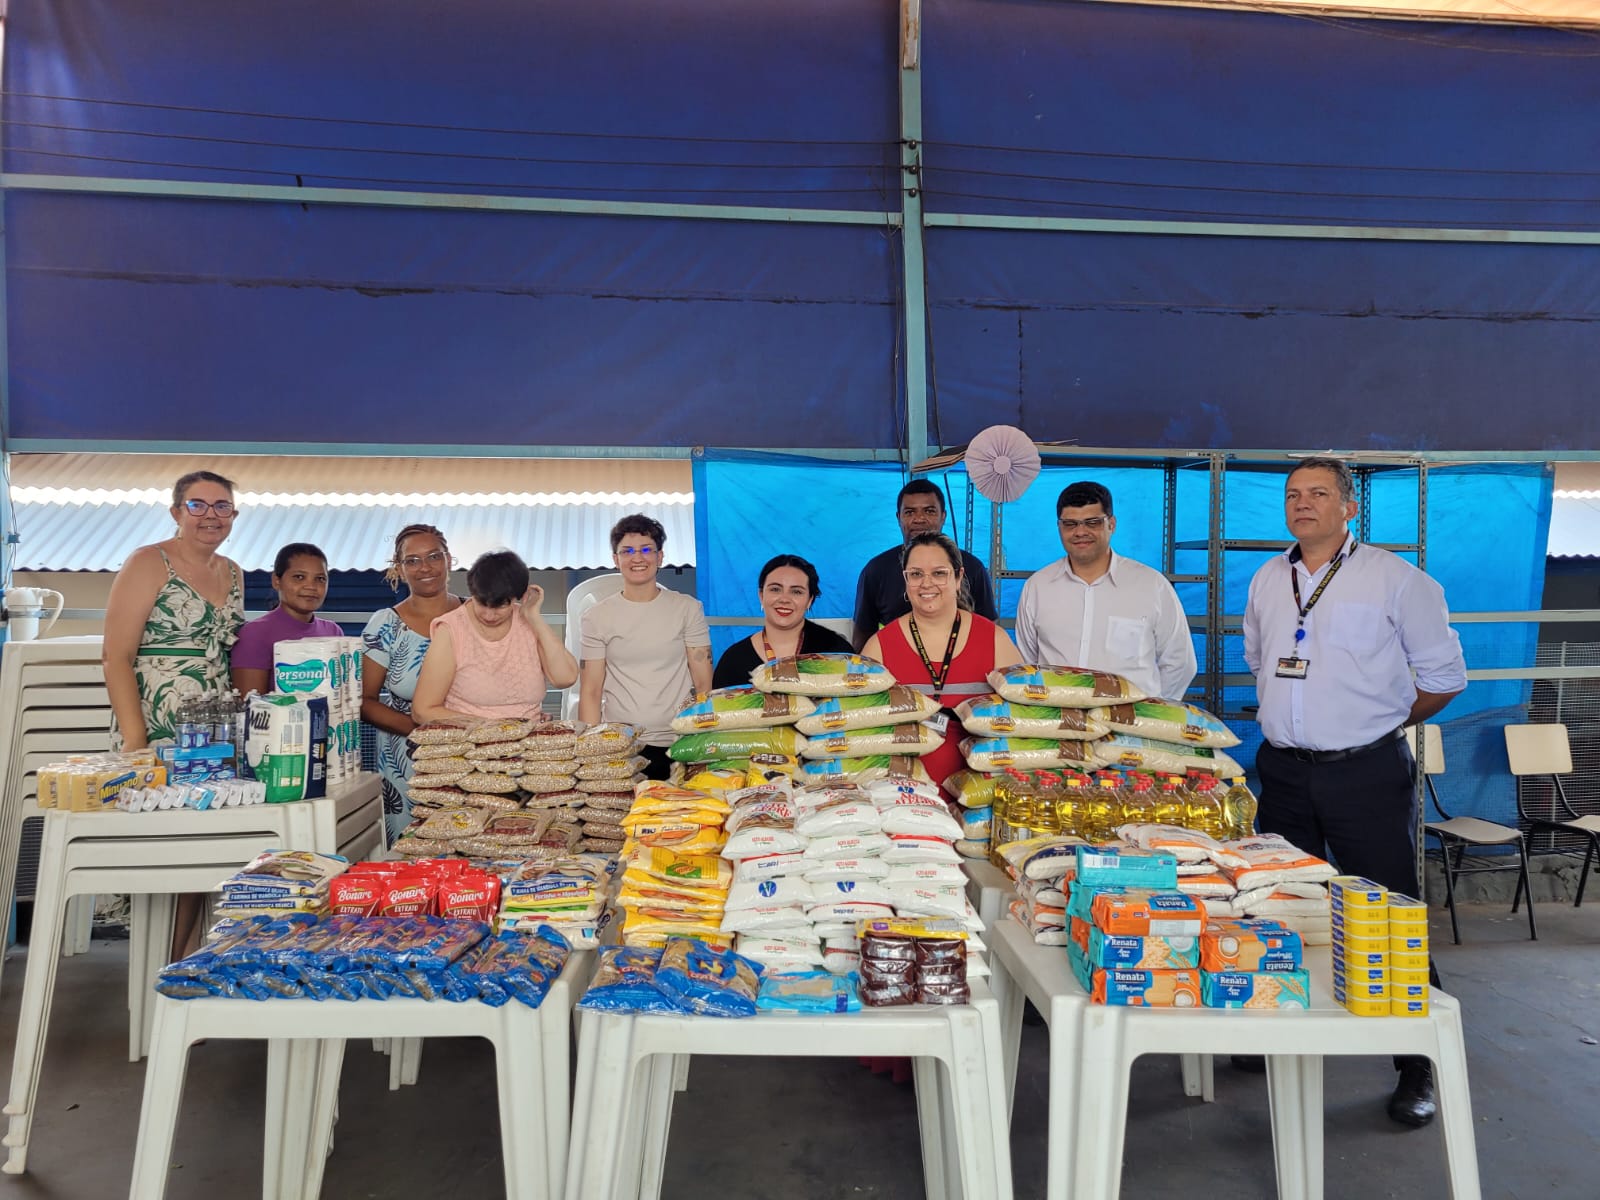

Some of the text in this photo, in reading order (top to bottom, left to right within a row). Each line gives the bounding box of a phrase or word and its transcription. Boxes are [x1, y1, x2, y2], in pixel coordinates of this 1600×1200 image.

[275, 669, 327, 680] Personal
[249, 710, 271, 731] Mili
[338, 889, 373, 902] Bonare
[389, 888, 426, 902] Bonare
[448, 891, 484, 904] Bonare
[341, 906, 364, 914] EXTRATO
[394, 905, 419, 913] EXTRATO
[454, 908, 478, 916] EXTRATO
[1111, 938, 1137, 946] Renata
[1266, 962, 1294, 971] Renata
[1115, 972, 1145, 981] Renata
[1220, 975, 1248, 985] Renata
